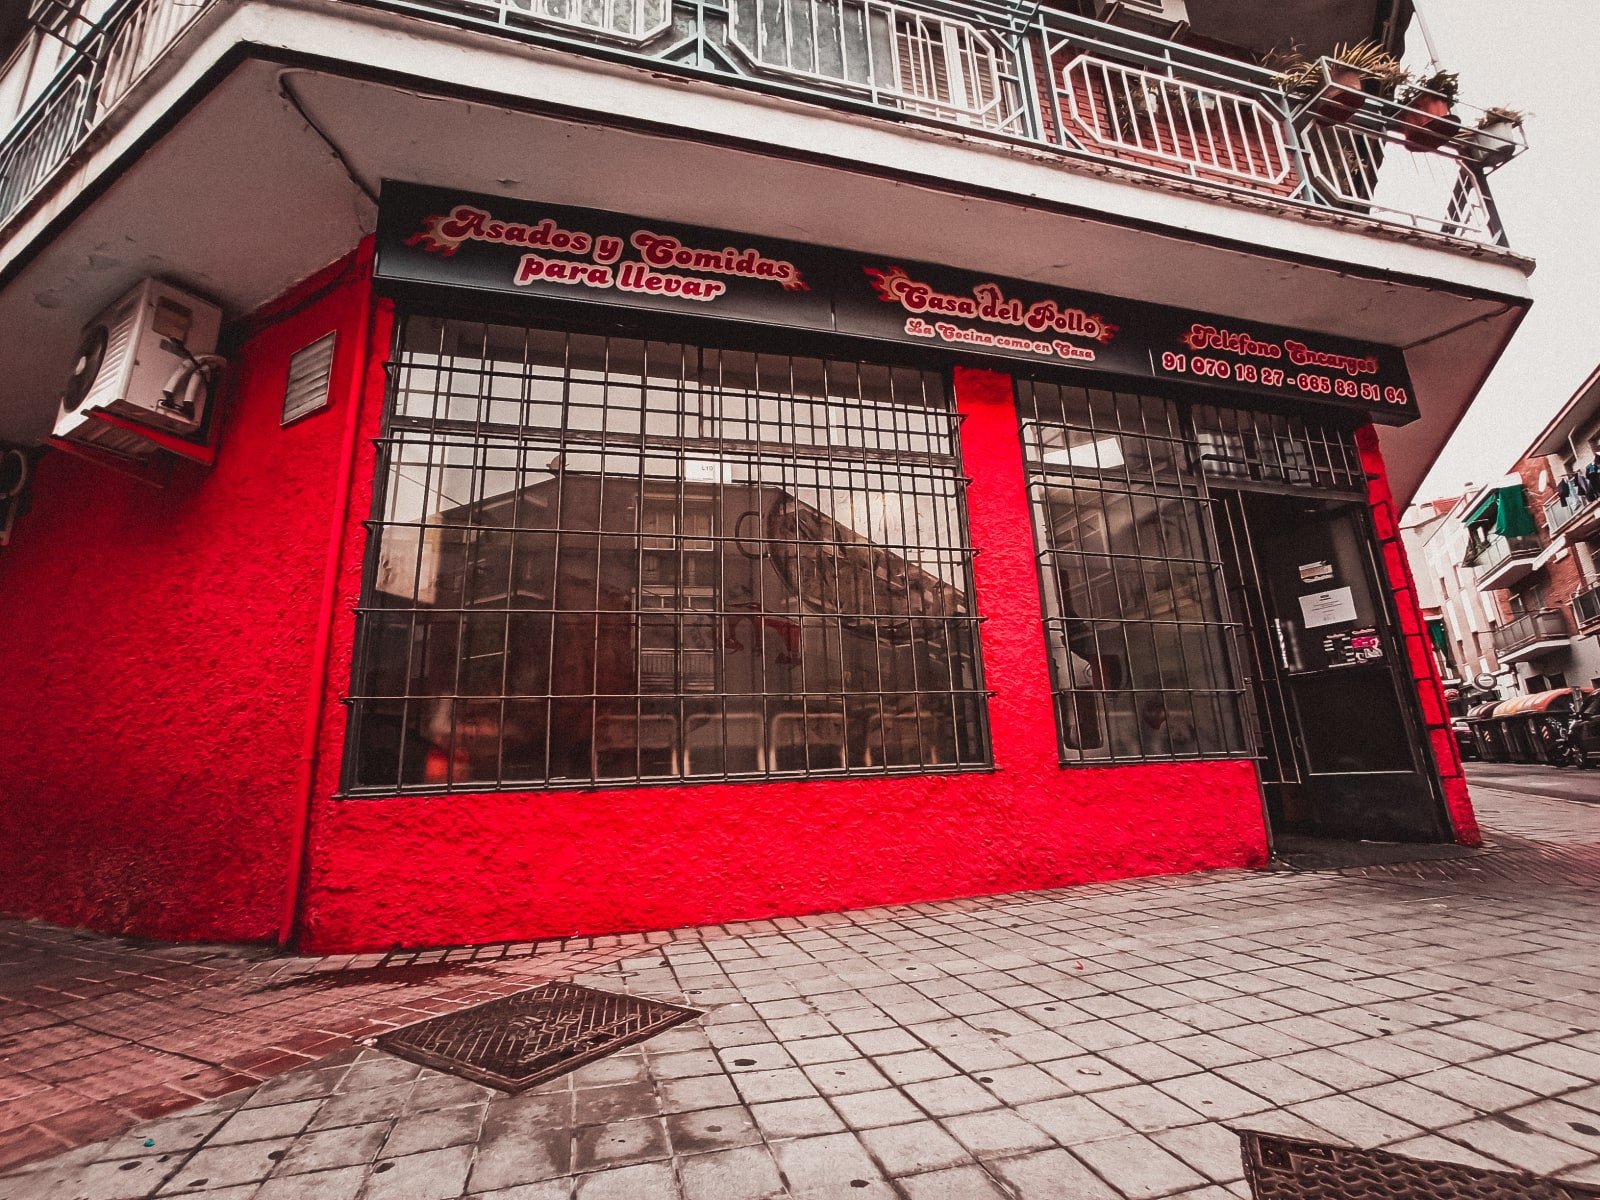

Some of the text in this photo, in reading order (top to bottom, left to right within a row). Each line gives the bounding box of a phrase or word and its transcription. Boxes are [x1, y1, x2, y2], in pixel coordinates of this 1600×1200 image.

[440, 207, 792, 279] Asados y Comidas
[517, 255, 724, 298] para llevar
[894, 281, 1097, 334] Casa del Pollo
[906, 319, 1094, 359] La Cocina como en Casa
[1163, 353, 1184, 371] 91
[1192, 357, 1230, 377] 070
[1236, 364, 1256, 381] 18
[1262, 368, 1283, 385] 27
[1299, 375, 1330, 392] 665
[1336, 380, 1357, 396] 83
[1362, 384, 1380, 400] 51
[1386, 388, 1406, 403] 64
